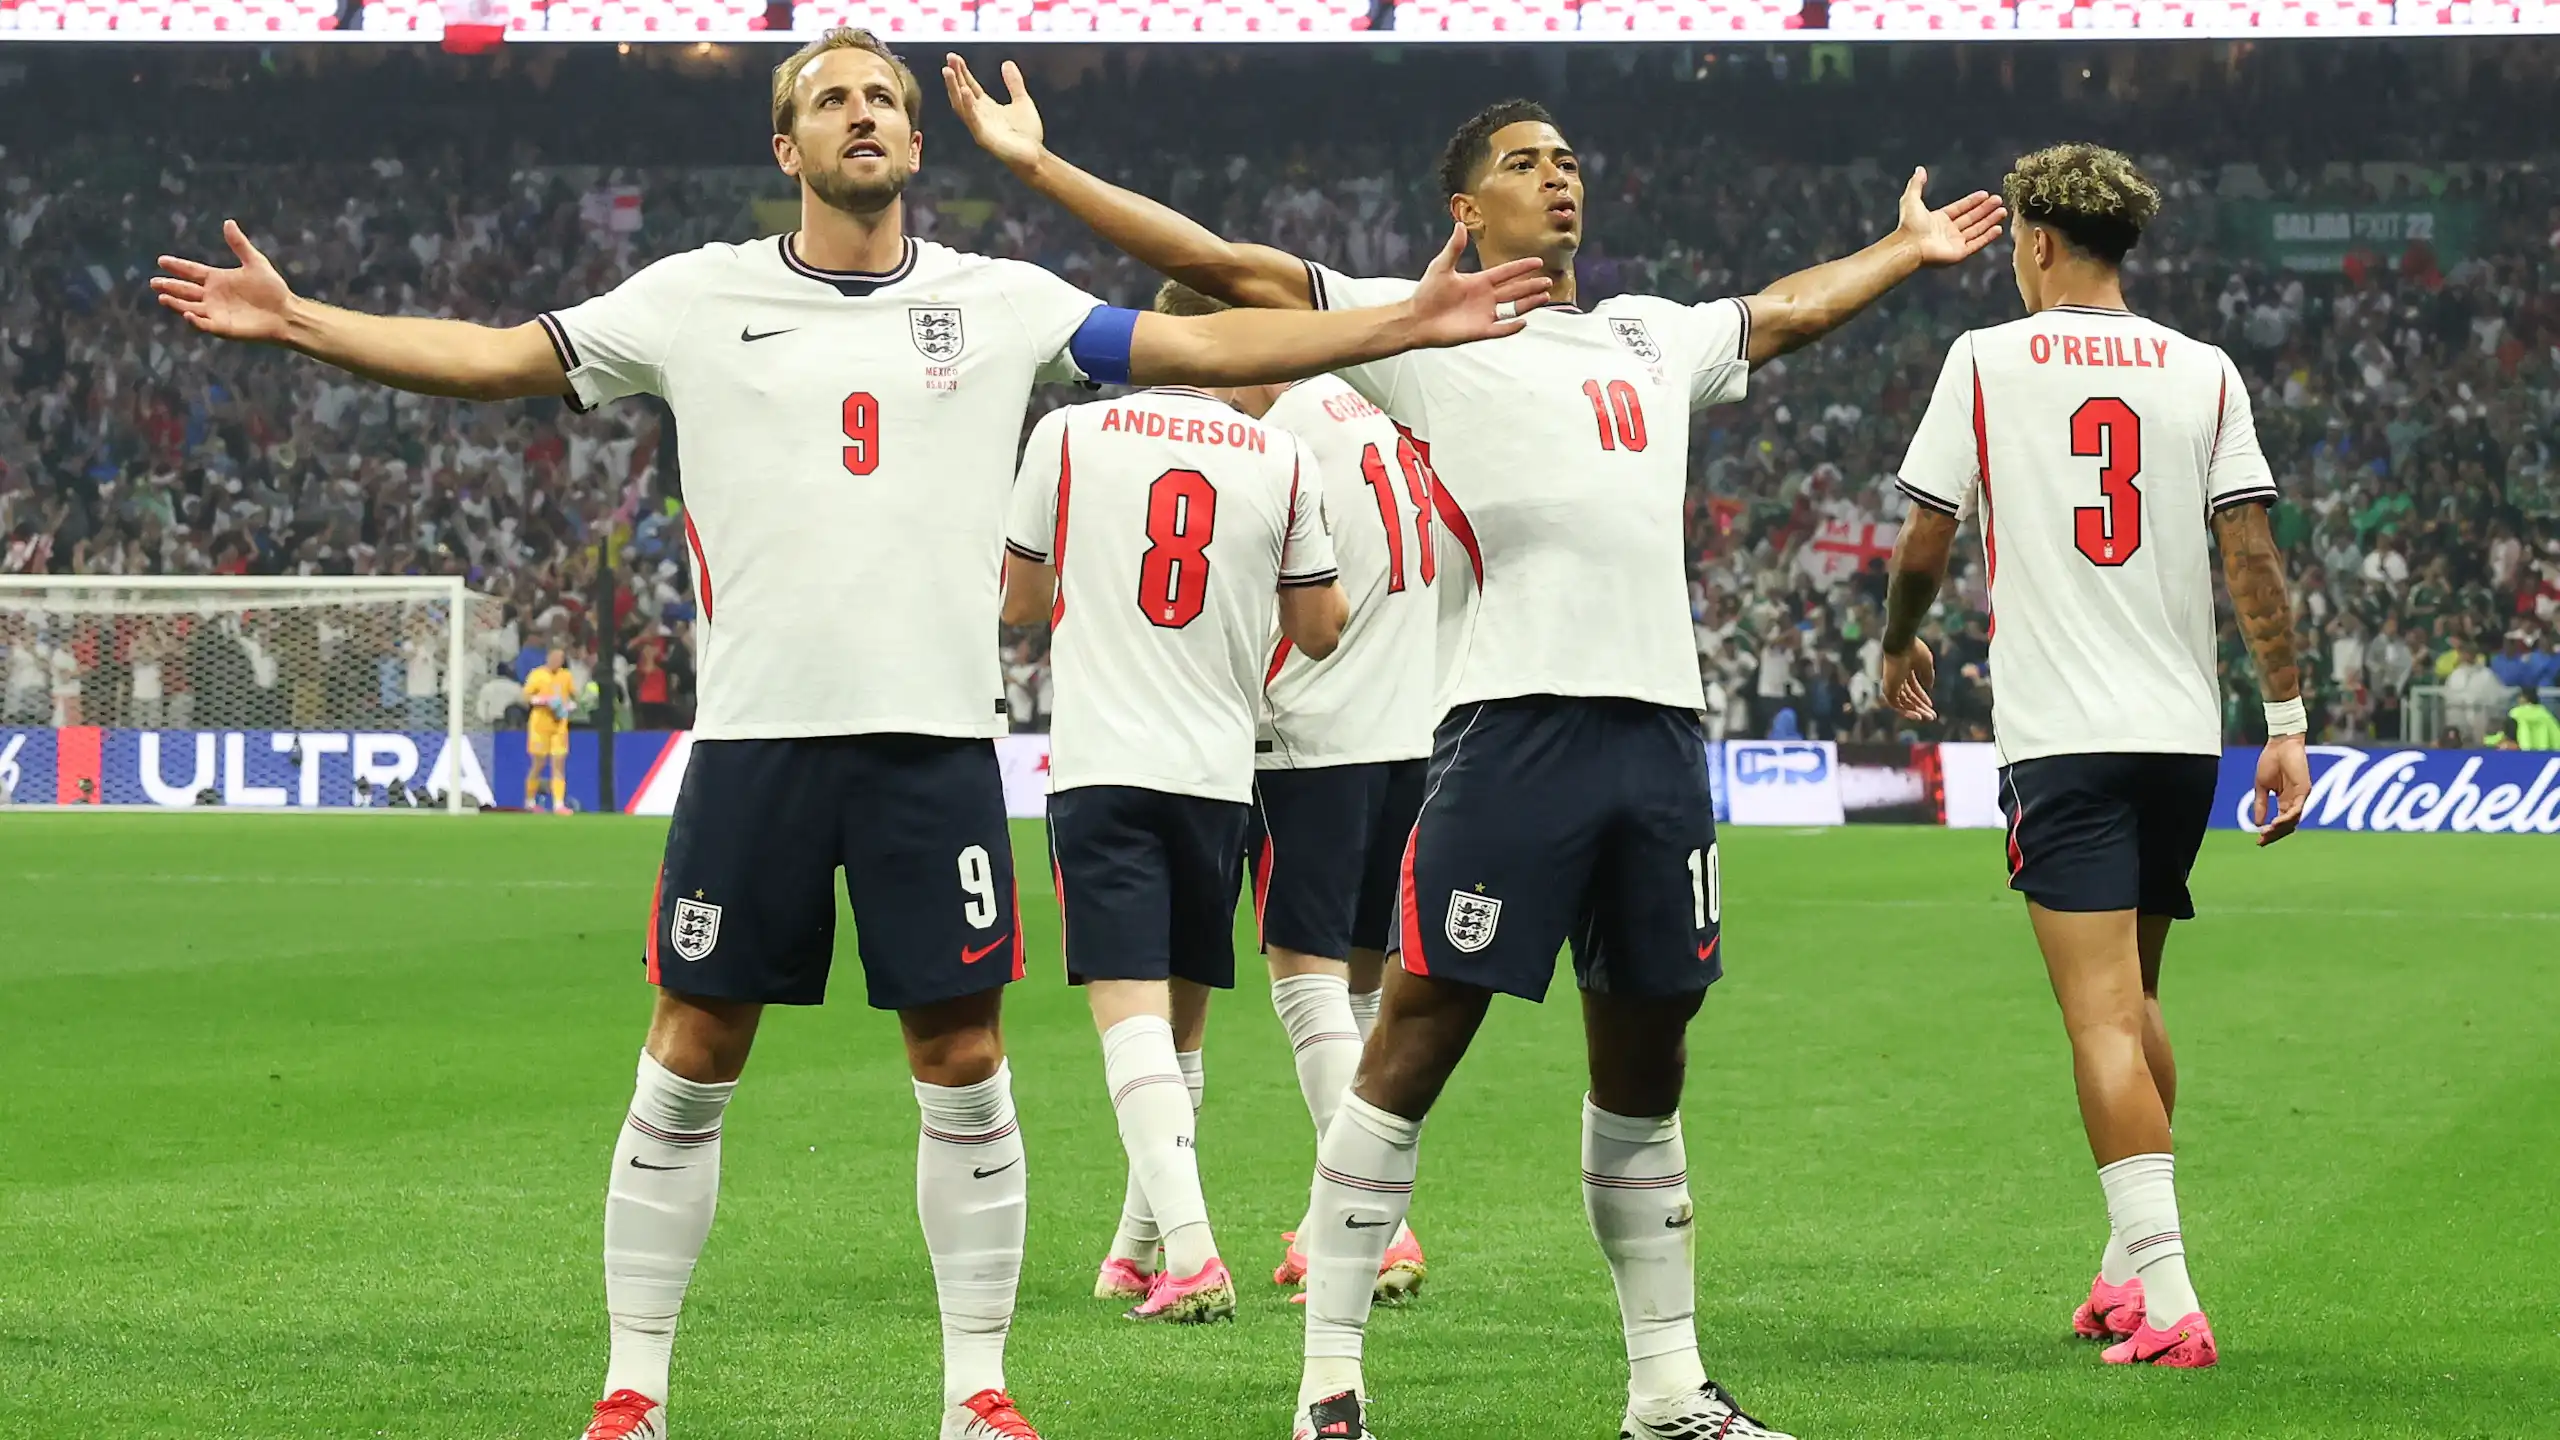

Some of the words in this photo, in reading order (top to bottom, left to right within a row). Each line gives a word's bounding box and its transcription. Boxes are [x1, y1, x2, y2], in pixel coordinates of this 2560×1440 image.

[925, 366, 958, 377] MEXICO
[2029, 333, 2169, 369] O'REILLY
[842, 391, 880, 476] 9
[1101, 407, 1267, 454] ANDERSON
[1581, 378, 1648, 453] 10
[2069, 396, 2142, 567] 3
[1136, 467, 1218, 630] 8
[137, 731, 497, 807] ULTRA
[956, 843, 998, 930] 9
[1686, 842, 1721, 930] 10
